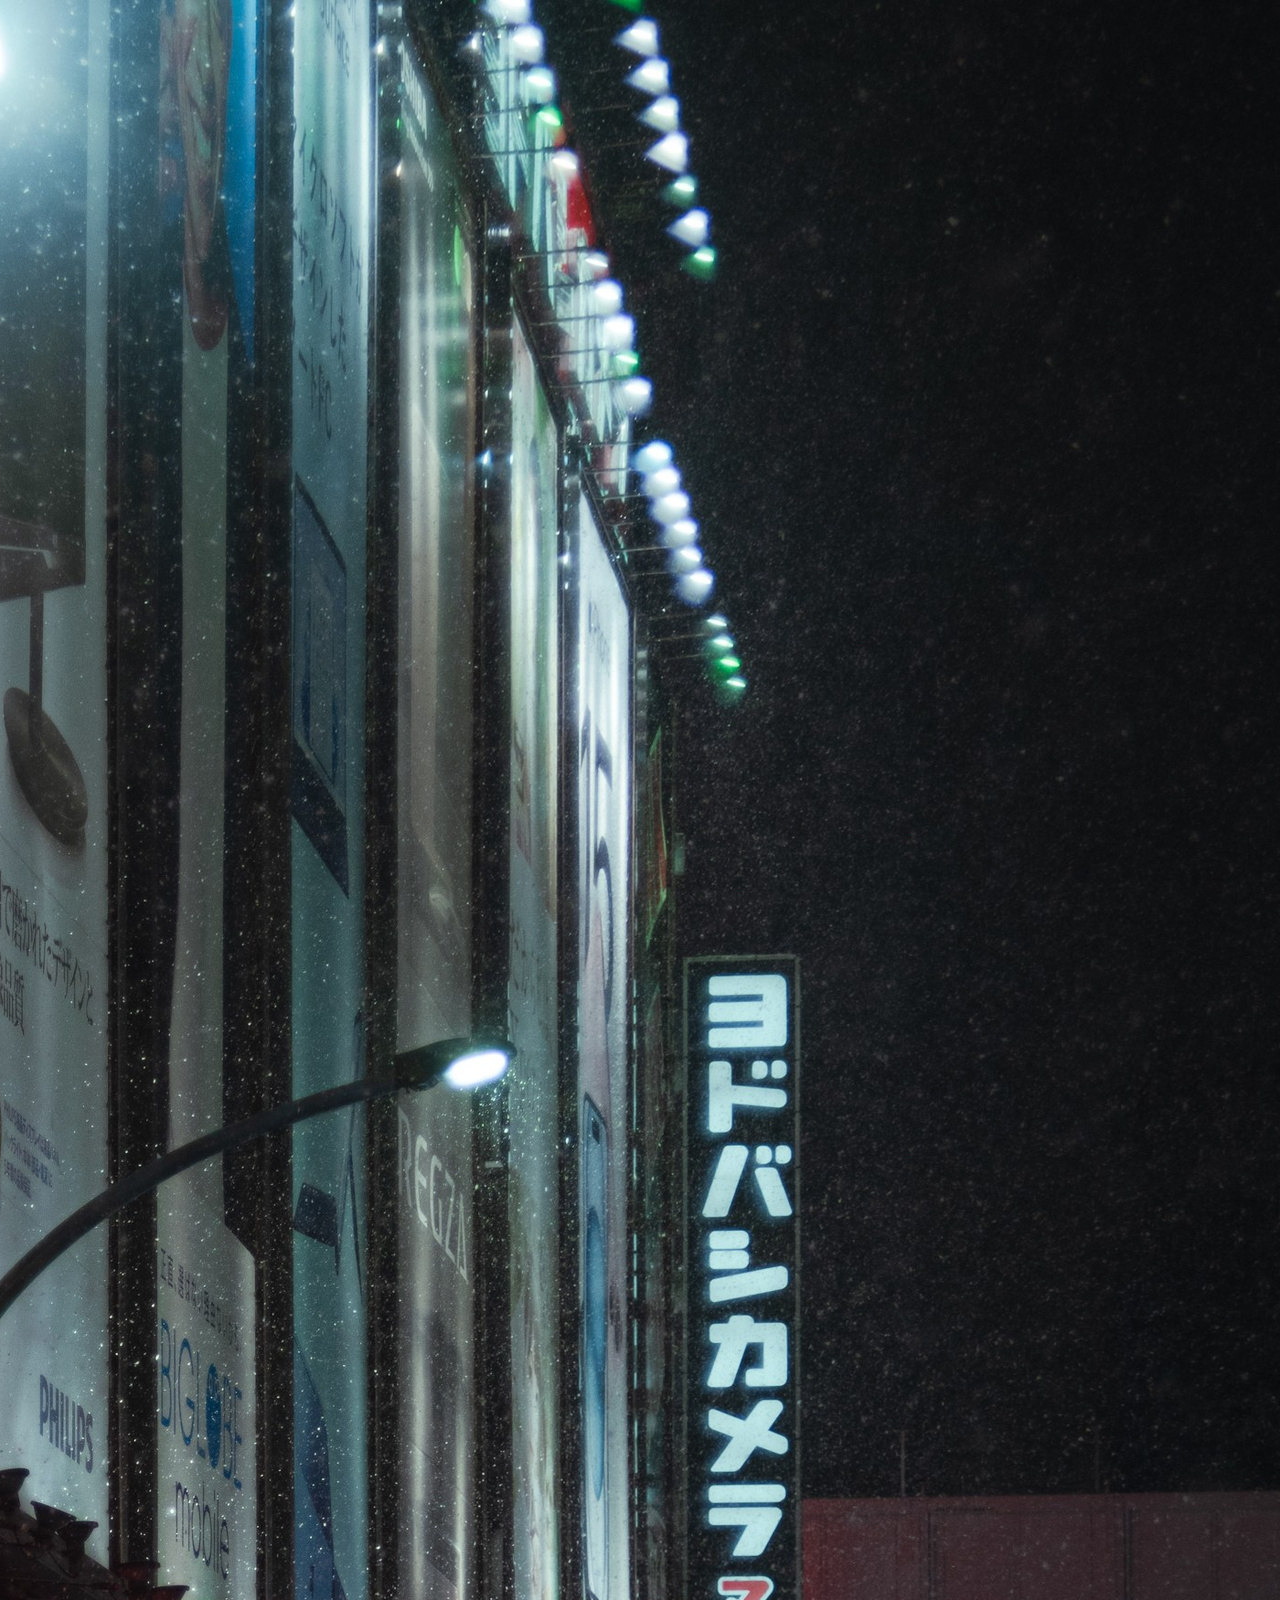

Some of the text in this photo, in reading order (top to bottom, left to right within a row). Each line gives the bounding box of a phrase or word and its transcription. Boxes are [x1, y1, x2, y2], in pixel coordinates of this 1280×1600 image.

[397, 1105, 468, 1283] REGZA
[701, 973, 793, 1557] ヨドバシカメラ
[38, 1373, 95, 1475] PHILIPS
[160, 1317, 242, 1491] BIGLOBE
[175, 1480, 230, 1581] mobile
